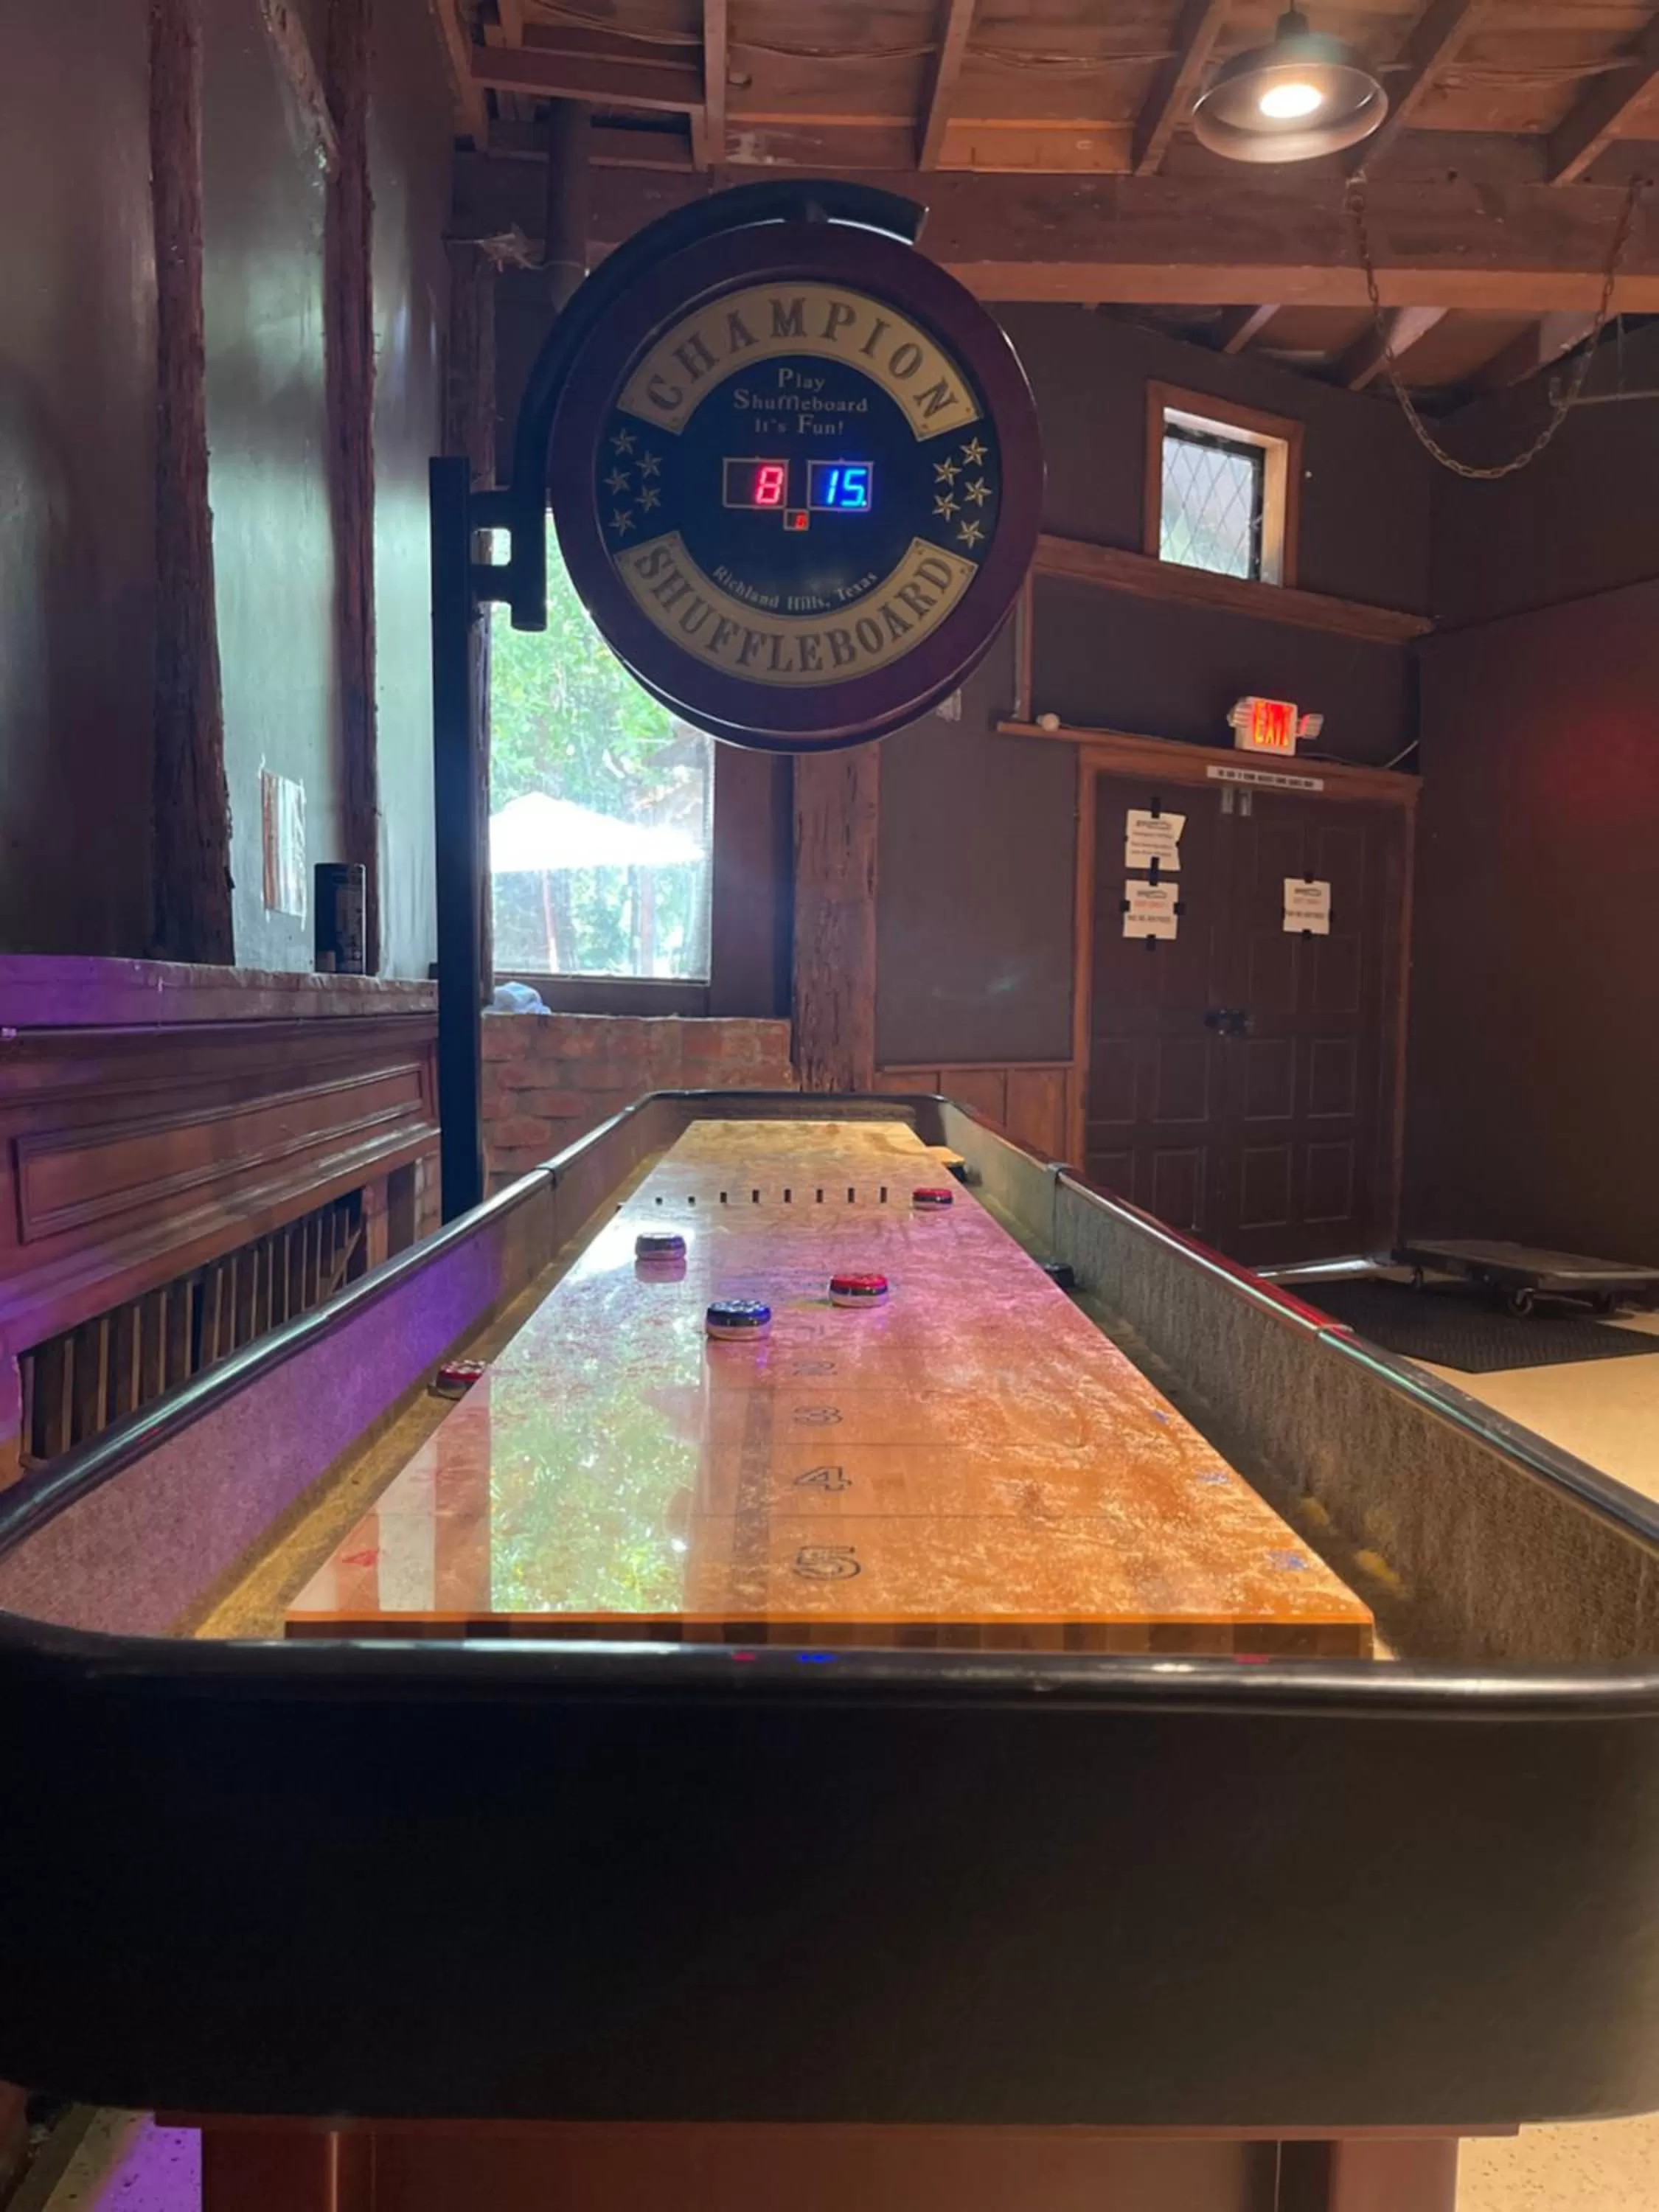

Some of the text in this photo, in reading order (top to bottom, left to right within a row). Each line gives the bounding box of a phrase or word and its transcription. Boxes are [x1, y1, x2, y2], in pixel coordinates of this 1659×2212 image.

[646, 297, 959, 420] CHAMPION
[777, 367, 827, 392] Play
[733, 388, 869, 413] Shuffleboard
[754, 413, 845, 435] It's Fun!
[755, 466, 785, 504] 8
[712, 565, 780, 608] Richland
[837, 572, 878, 601] Texas
[633, 545, 954, 673] SHUFFLEBOARD
[1254, 700, 1294, 748] EXIT
[793, 1405, 844, 1427] 3
[793, 1465, 853, 1492] 4
[792, 1544, 862, 1582] 5
